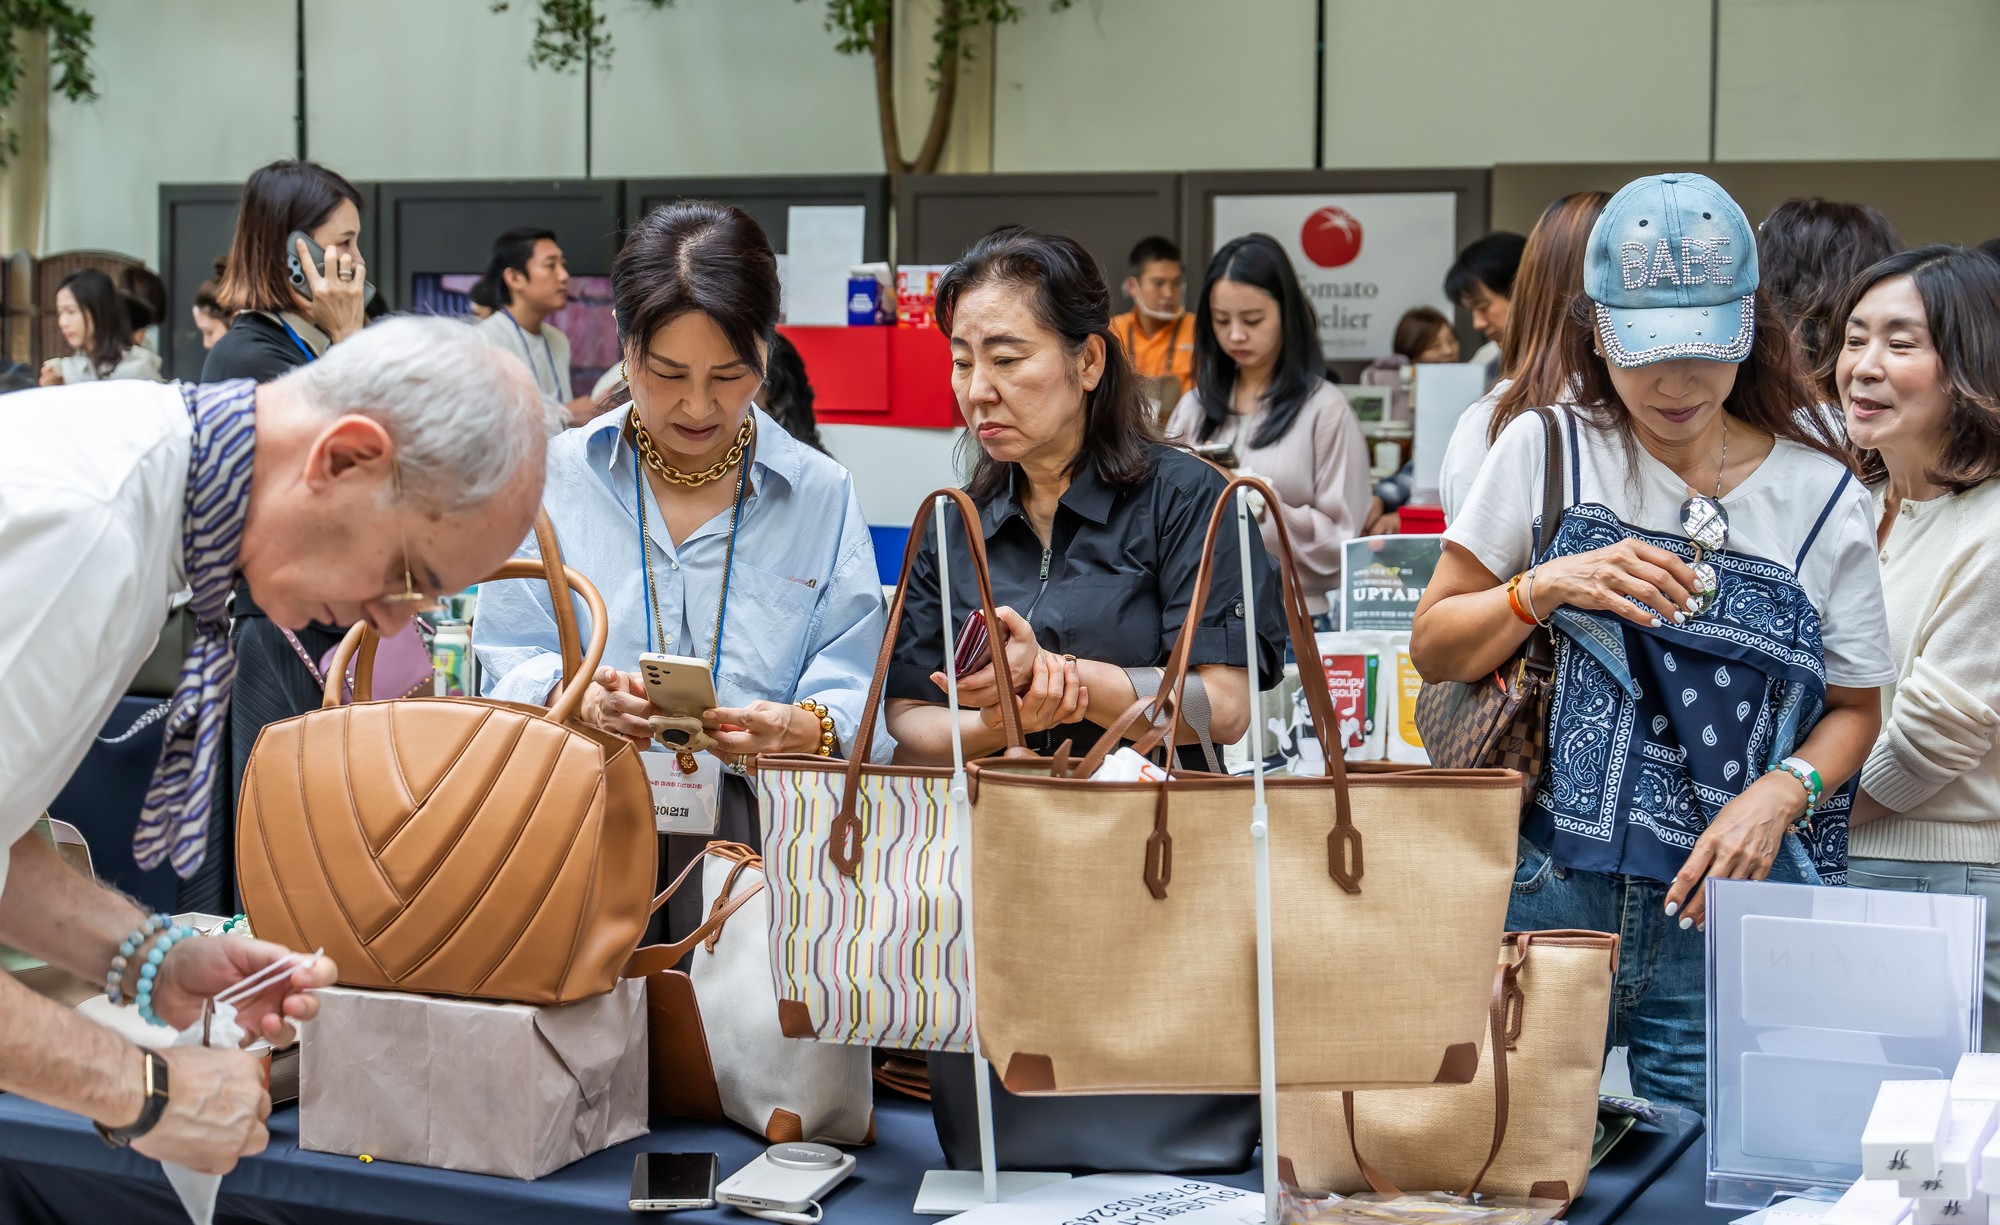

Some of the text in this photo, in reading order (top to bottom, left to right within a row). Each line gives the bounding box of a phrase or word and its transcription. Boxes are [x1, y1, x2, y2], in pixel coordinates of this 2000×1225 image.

[1621, 236, 1733, 290] BABE
[1300, 274, 1379, 299] omato
[1317, 304, 1372, 329] elier
